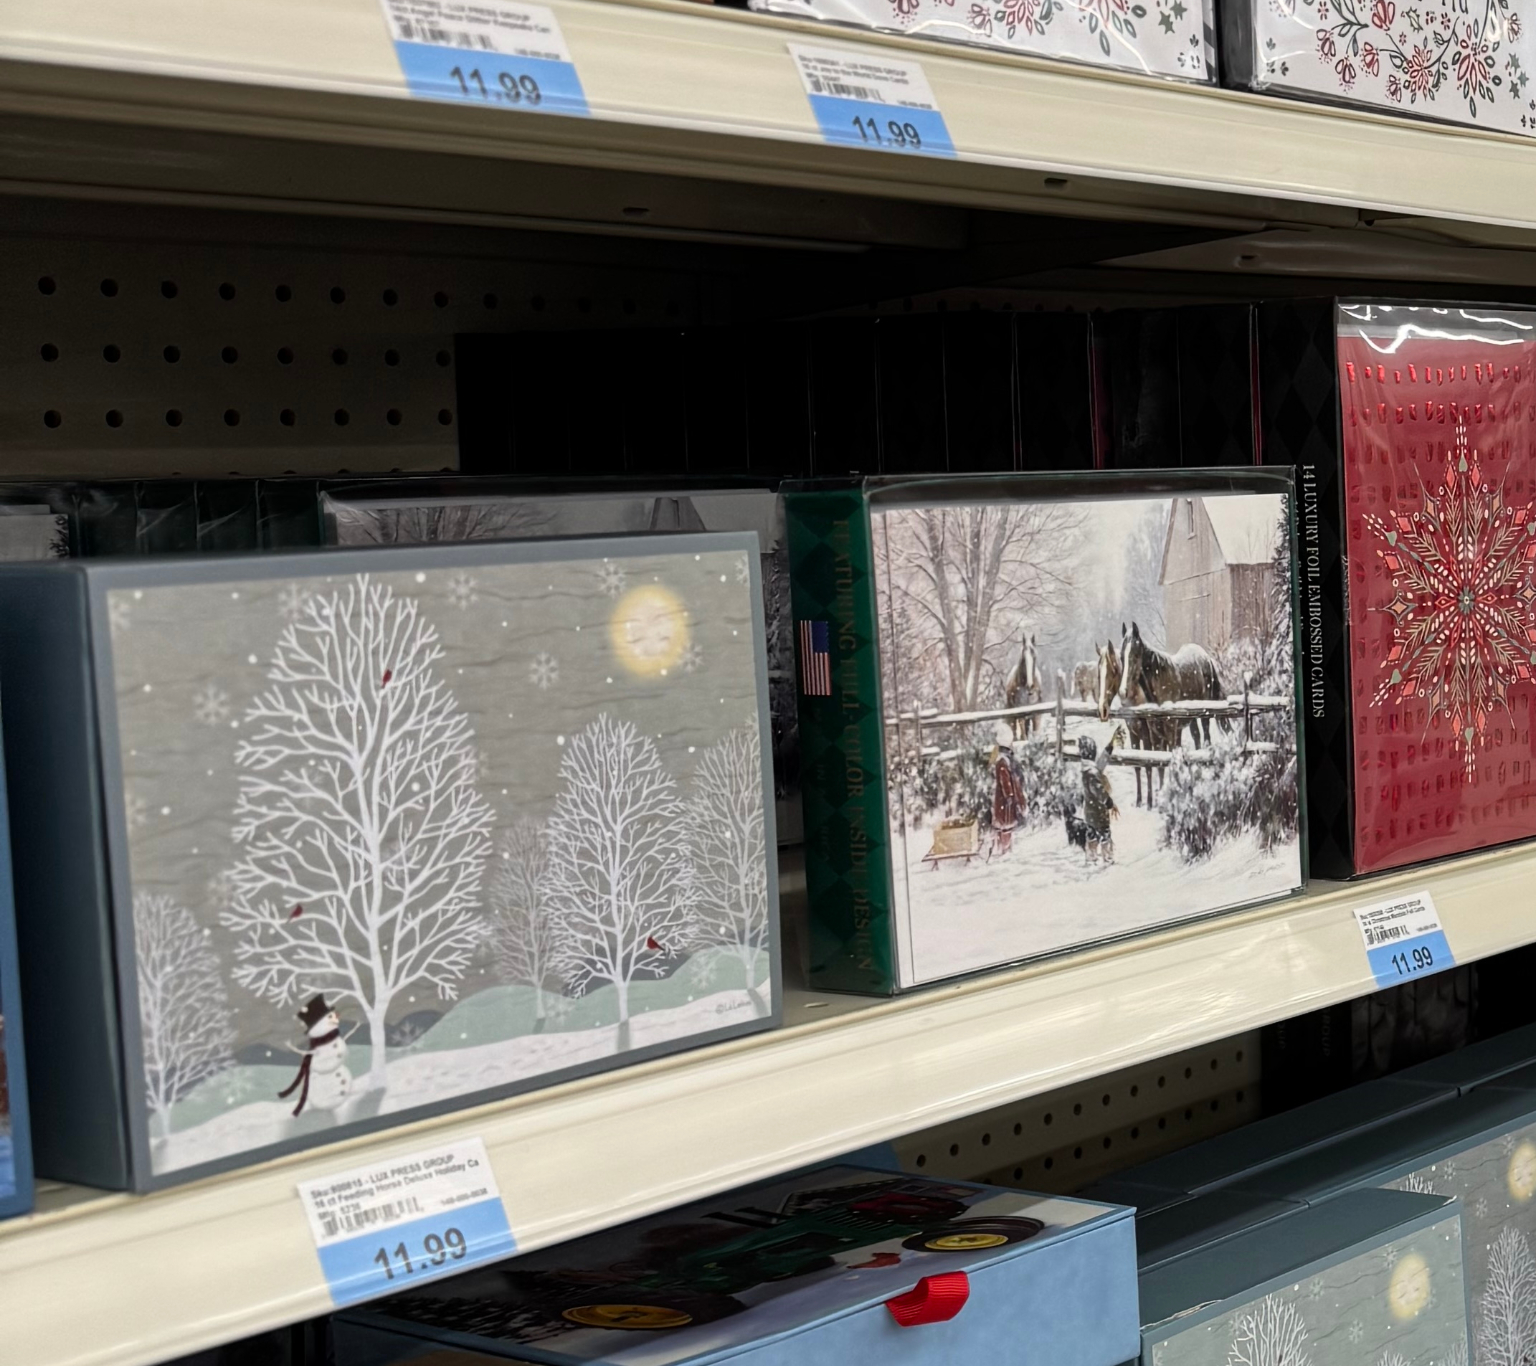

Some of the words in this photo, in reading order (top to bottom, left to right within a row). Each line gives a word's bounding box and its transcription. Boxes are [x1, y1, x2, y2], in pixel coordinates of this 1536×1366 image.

[450, 66, 541, 106] 11.99
[852, 115, 922, 149] 11.99
[1302, 463, 1316, 479] 14
[1302, 481, 1319, 543] LUXURY
[1306, 544, 1320, 575] FOIL
[1307, 576, 1324, 668] EMBOSSED
[1310, 668, 1326, 720] CARDS
[1391, 945, 1434, 975] 11.99
[336, 1185, 375, 1204] Feeding
[402, 1169, 434, 1186] Deluxe
[433, 1161, 466, 1178] Holiday
[389, 1162, 422, 1178] PRESS
[421, 1153, 455, 1169] GROUP
[373, 1227, 468, 1280] 11.99
